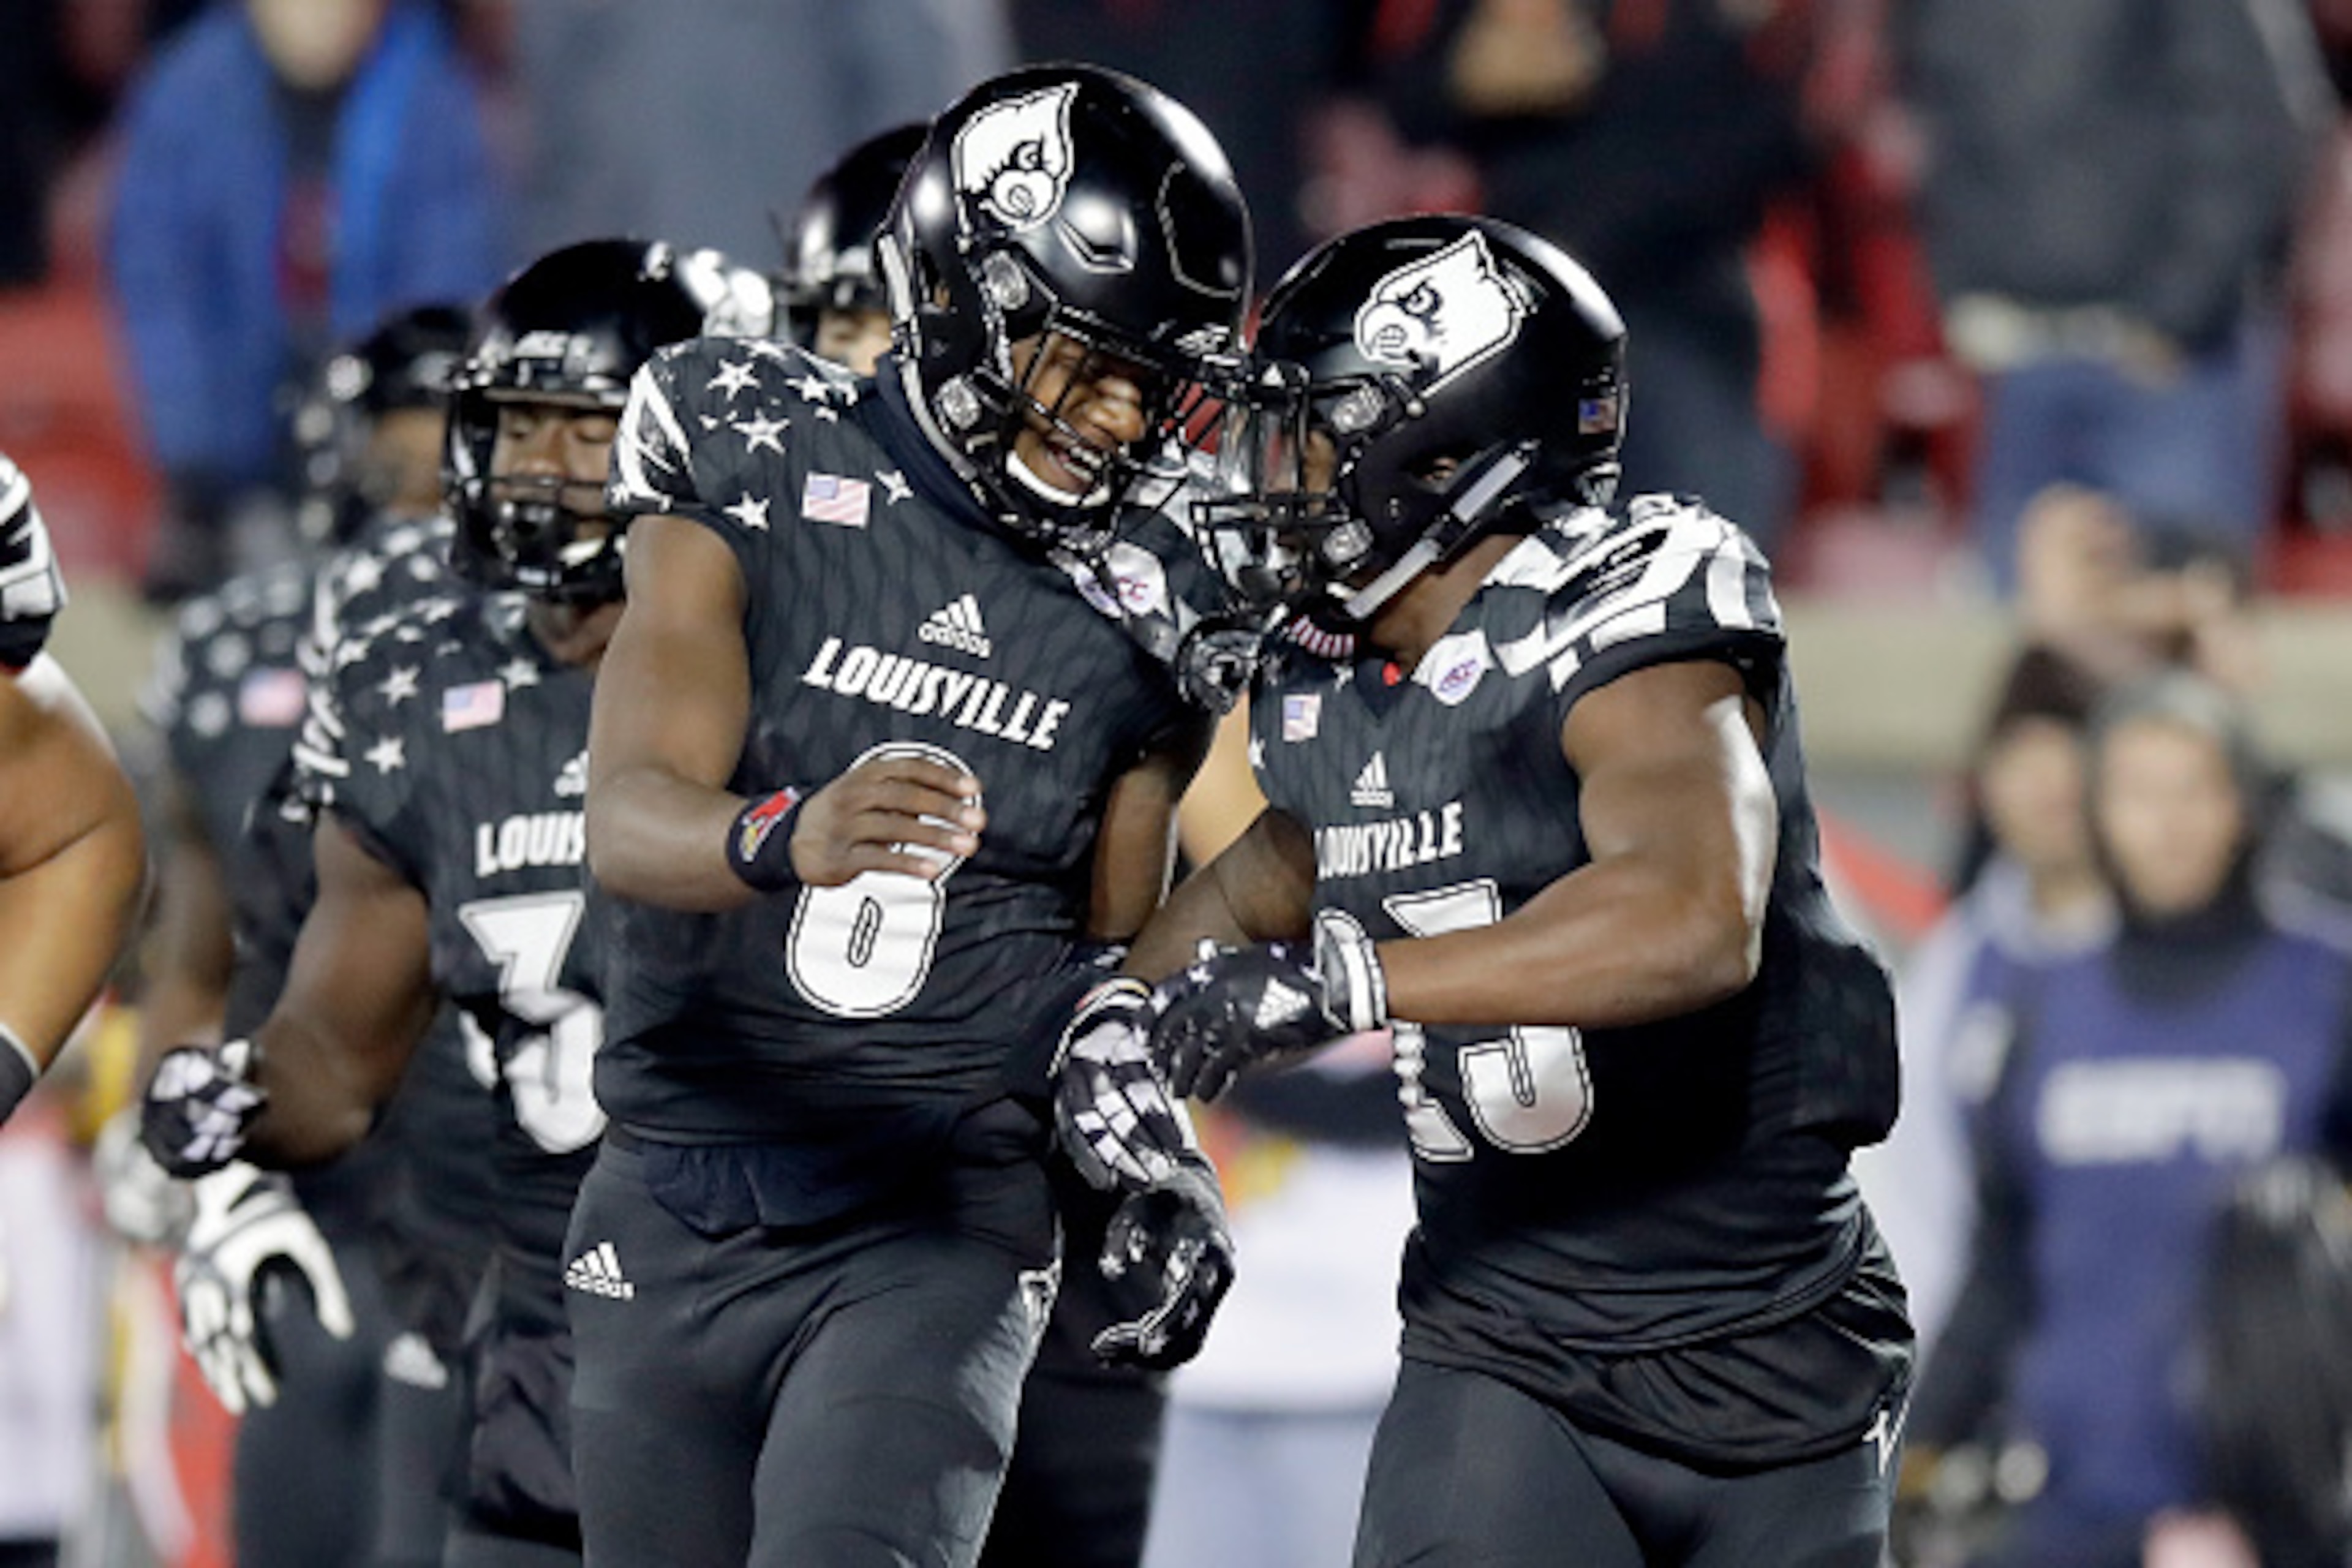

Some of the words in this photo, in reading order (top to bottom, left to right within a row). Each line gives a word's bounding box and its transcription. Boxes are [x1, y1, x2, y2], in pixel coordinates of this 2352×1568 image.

[918, 621, 992, 658] adidas
[802, 635, 1071, 751] LOUISVILLE
[475, 810, 586, 878] LOUIS
[1314, 801, 1463, 881] LOUISVILLE
